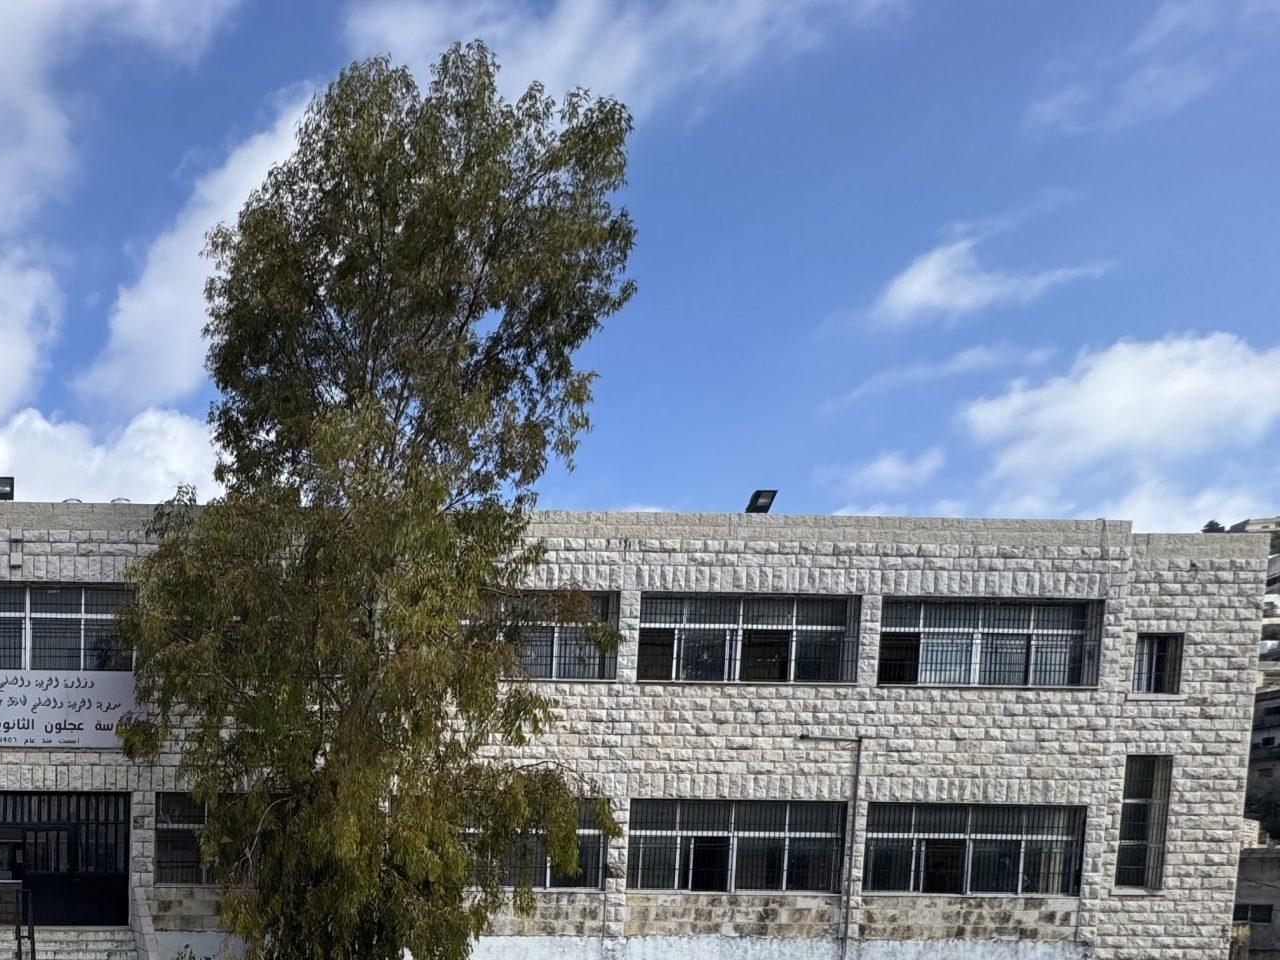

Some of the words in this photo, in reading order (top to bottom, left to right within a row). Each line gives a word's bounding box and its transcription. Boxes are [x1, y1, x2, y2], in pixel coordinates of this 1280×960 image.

[35, 676, 60, 691] التربية
[64, 676, 95, 689] وزارة
[31, 696, 64, 714] والتعليم
[67, 697, 93, 712] التربية
[44, 719, 84, 734] عجلون
[23, 737, 35, 745] عام
